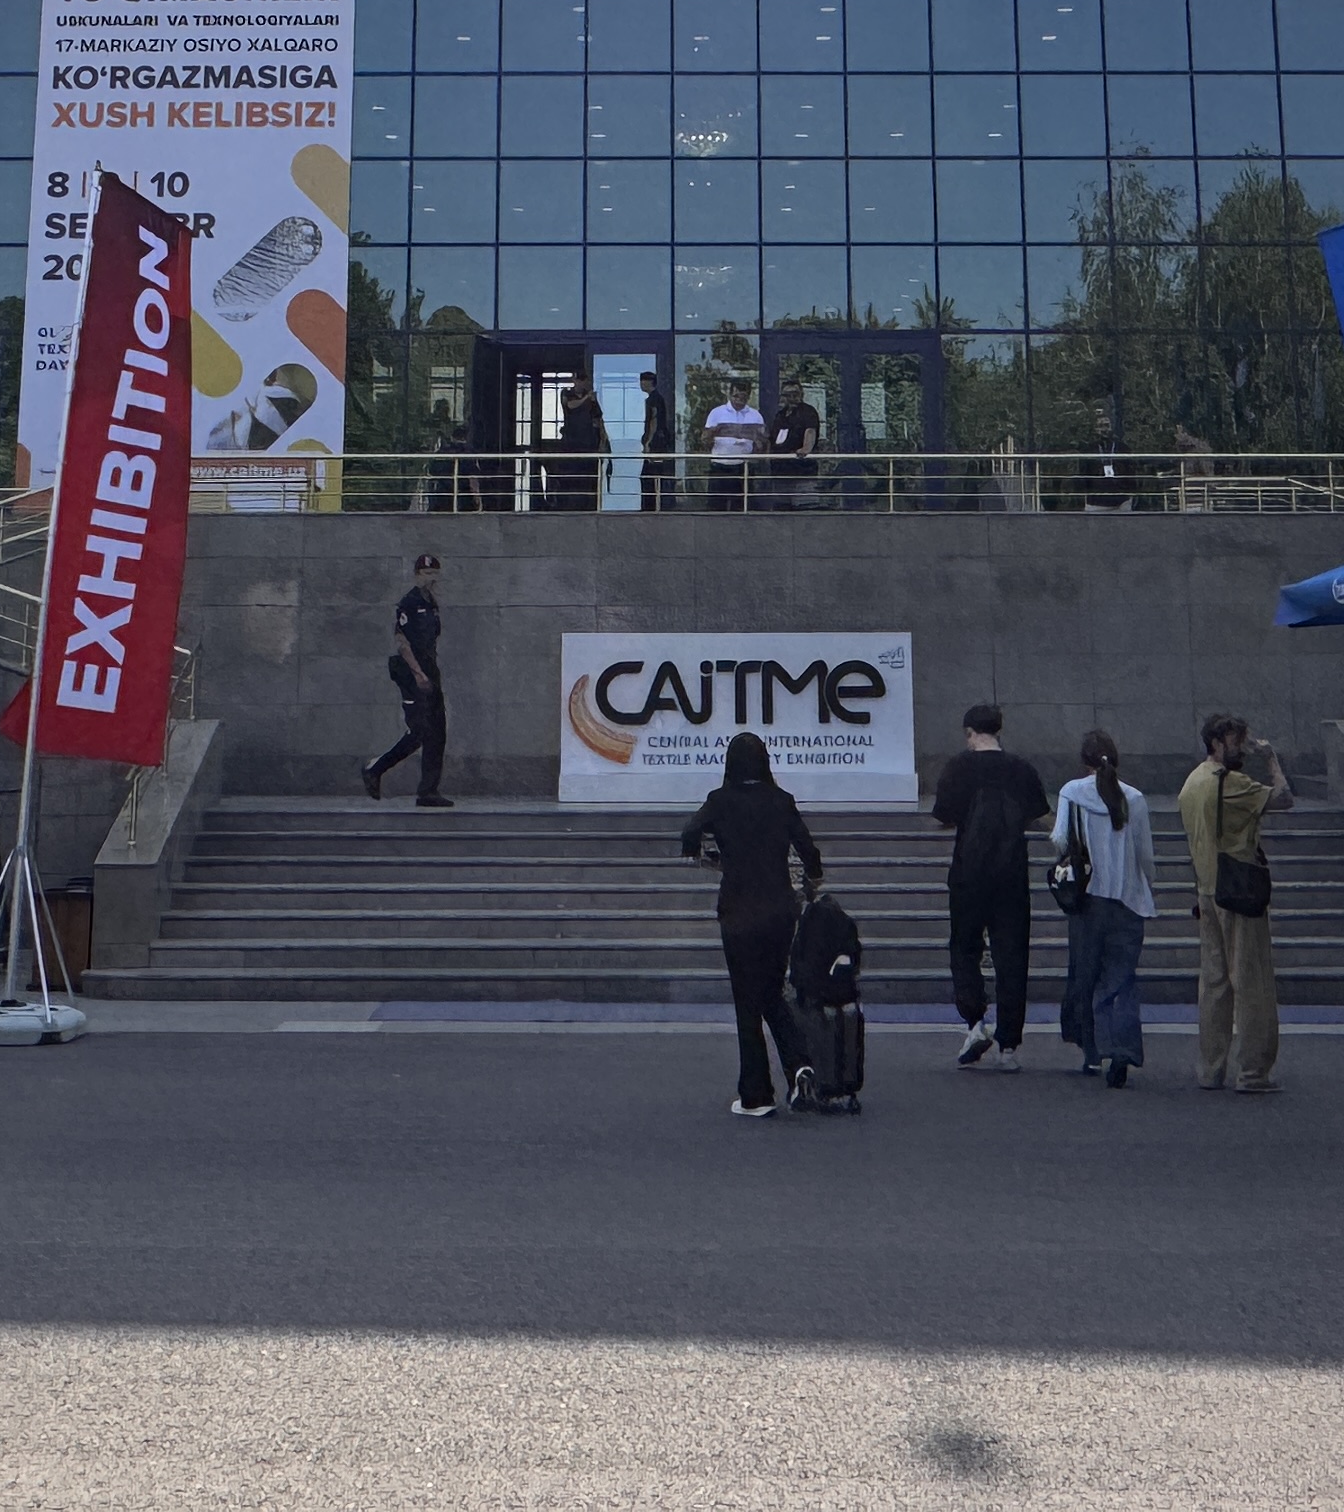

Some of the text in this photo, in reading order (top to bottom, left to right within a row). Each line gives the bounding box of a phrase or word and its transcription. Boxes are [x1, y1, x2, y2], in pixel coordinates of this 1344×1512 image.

[167, 15, 188, 27] VA
[183, 38, 242, 53] OSIYO
[247, 38, 340, 53] XALQARO
[51, 101, 337, 129] XUSH KELIBSIZ!
[47, 171, 190, 198] 8 10
[42, 254, 83, 281] 20
[36, 359, 69, 370] DAY
[56, 225, 171, 714] EXHIBITION
[647, 735, 709, 748] CENTRAL
